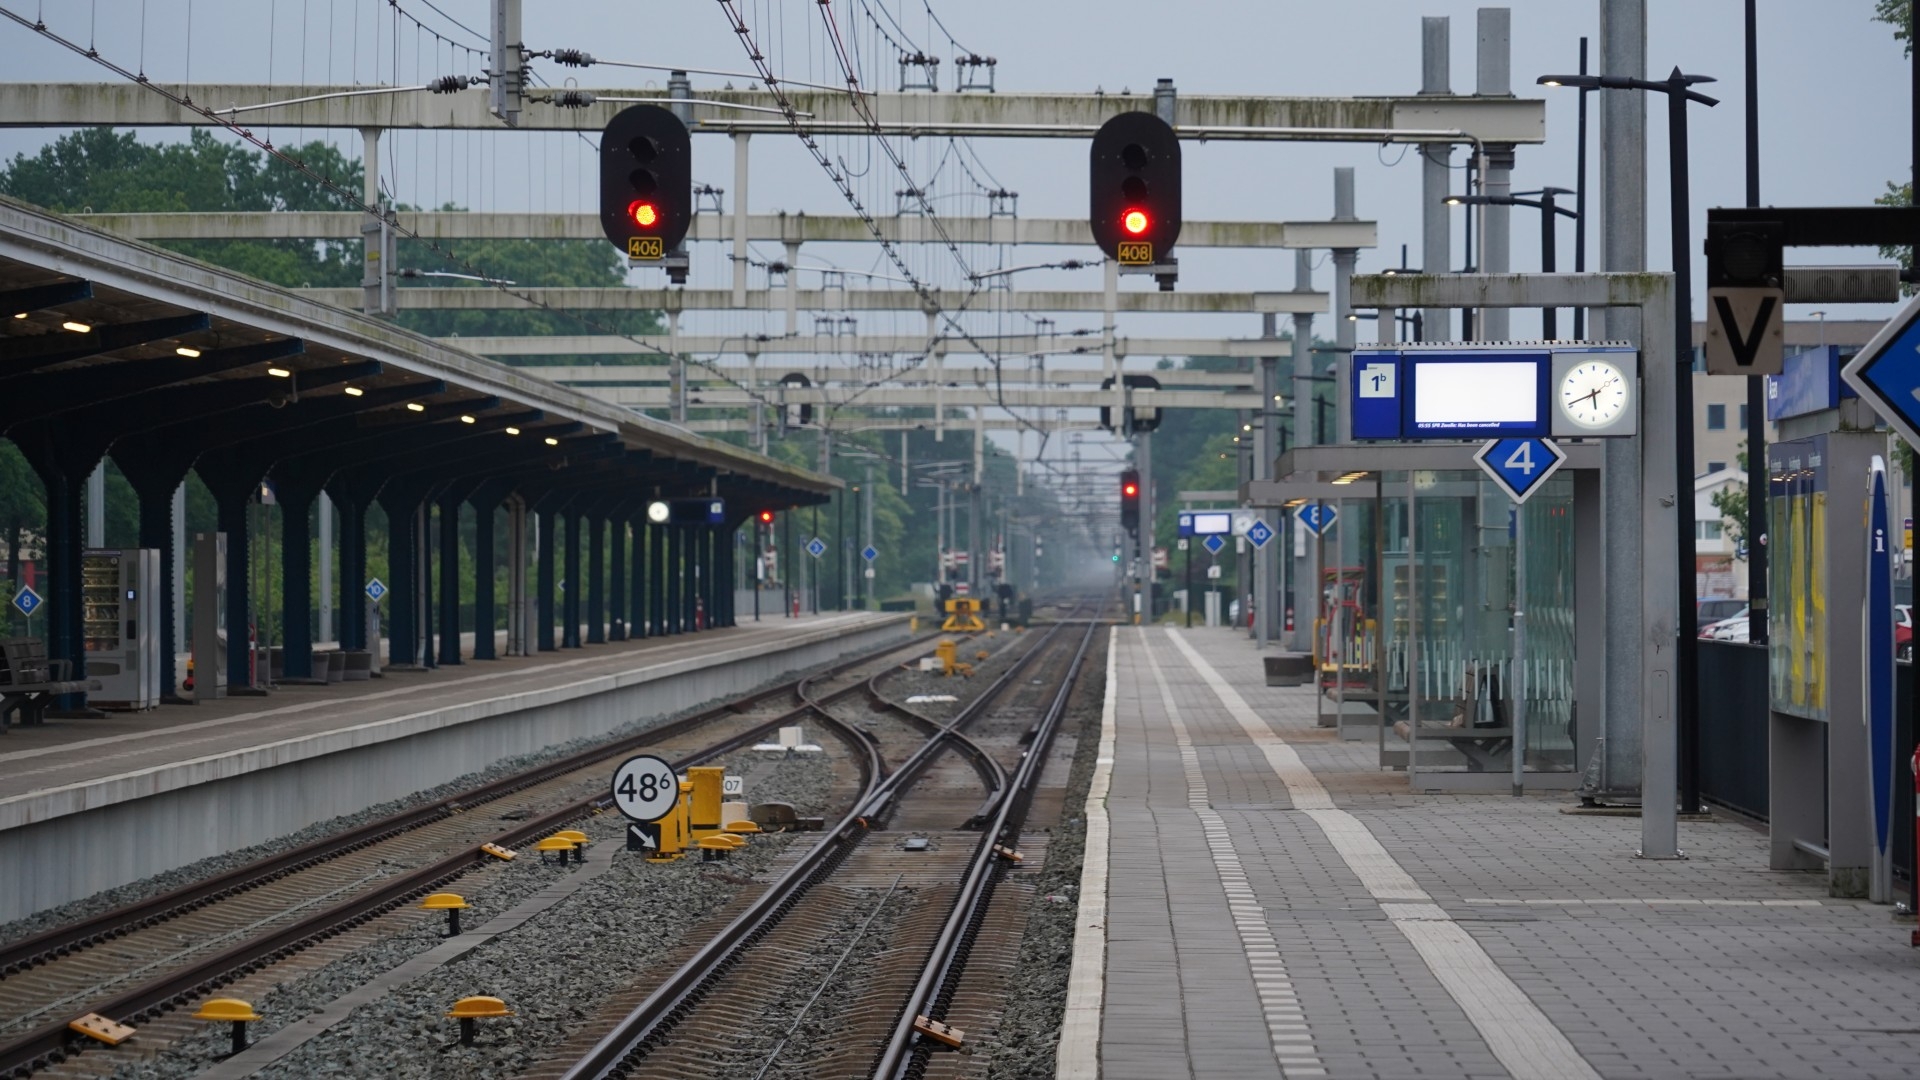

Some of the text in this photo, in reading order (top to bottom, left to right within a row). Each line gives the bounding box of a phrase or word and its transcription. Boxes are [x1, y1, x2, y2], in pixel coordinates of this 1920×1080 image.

[632, 240, 659, 256] 406
[1121, 245, 1149, 260] 408
[1712, 295, 1778, 366] V
[1504, 441, 1536, 475] 4
[1252, 528, 1267, 540] 10
[371, 585, 381, 596] 10
[23, 595, 32, 607] 8
[723, 780, 740, 791] 07
